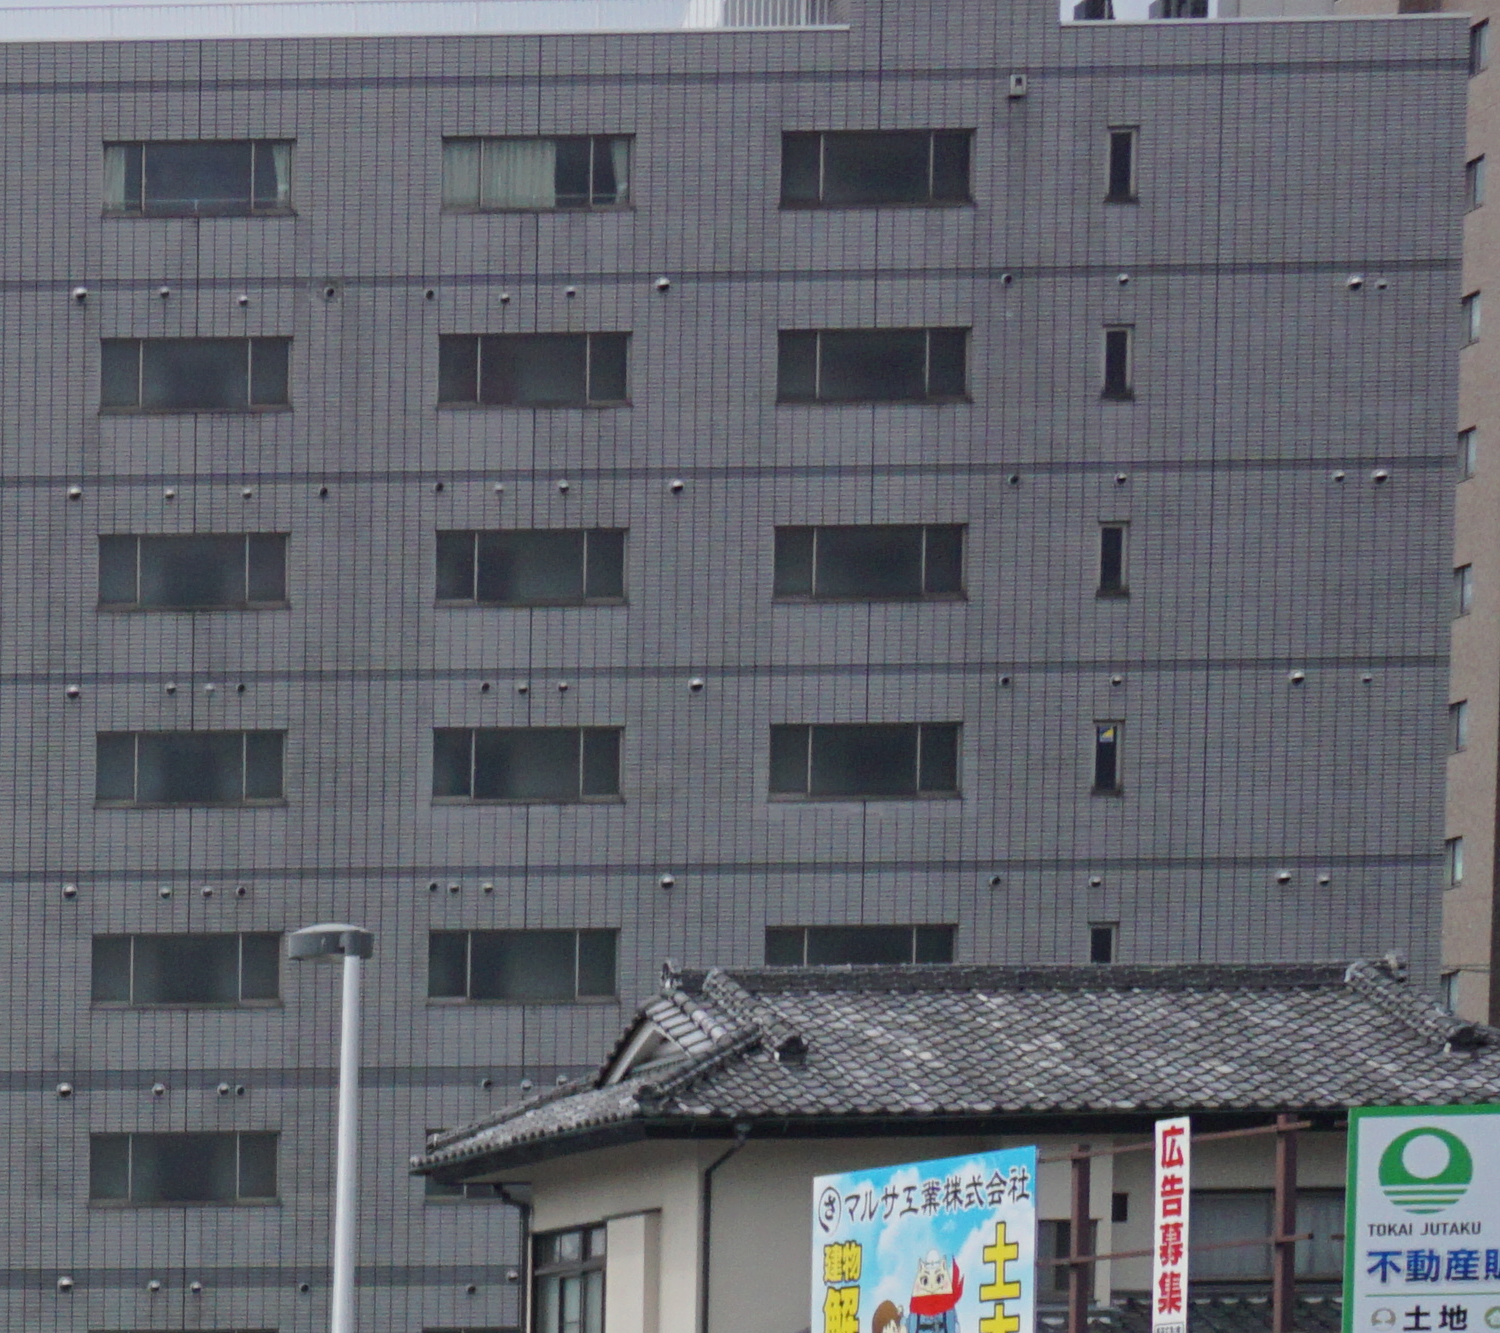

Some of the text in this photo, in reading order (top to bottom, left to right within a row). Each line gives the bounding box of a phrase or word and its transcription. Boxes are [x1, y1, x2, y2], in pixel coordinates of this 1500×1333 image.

[844, 1167, 1030, 1222] マルサ工業株式会社
[1158, 1125, 1184, 1314] 広告募集
[1368, 1221, 1482, 1236] TOKAI JUTAKU
[1403, 1305, 1468, 1332] 土地
